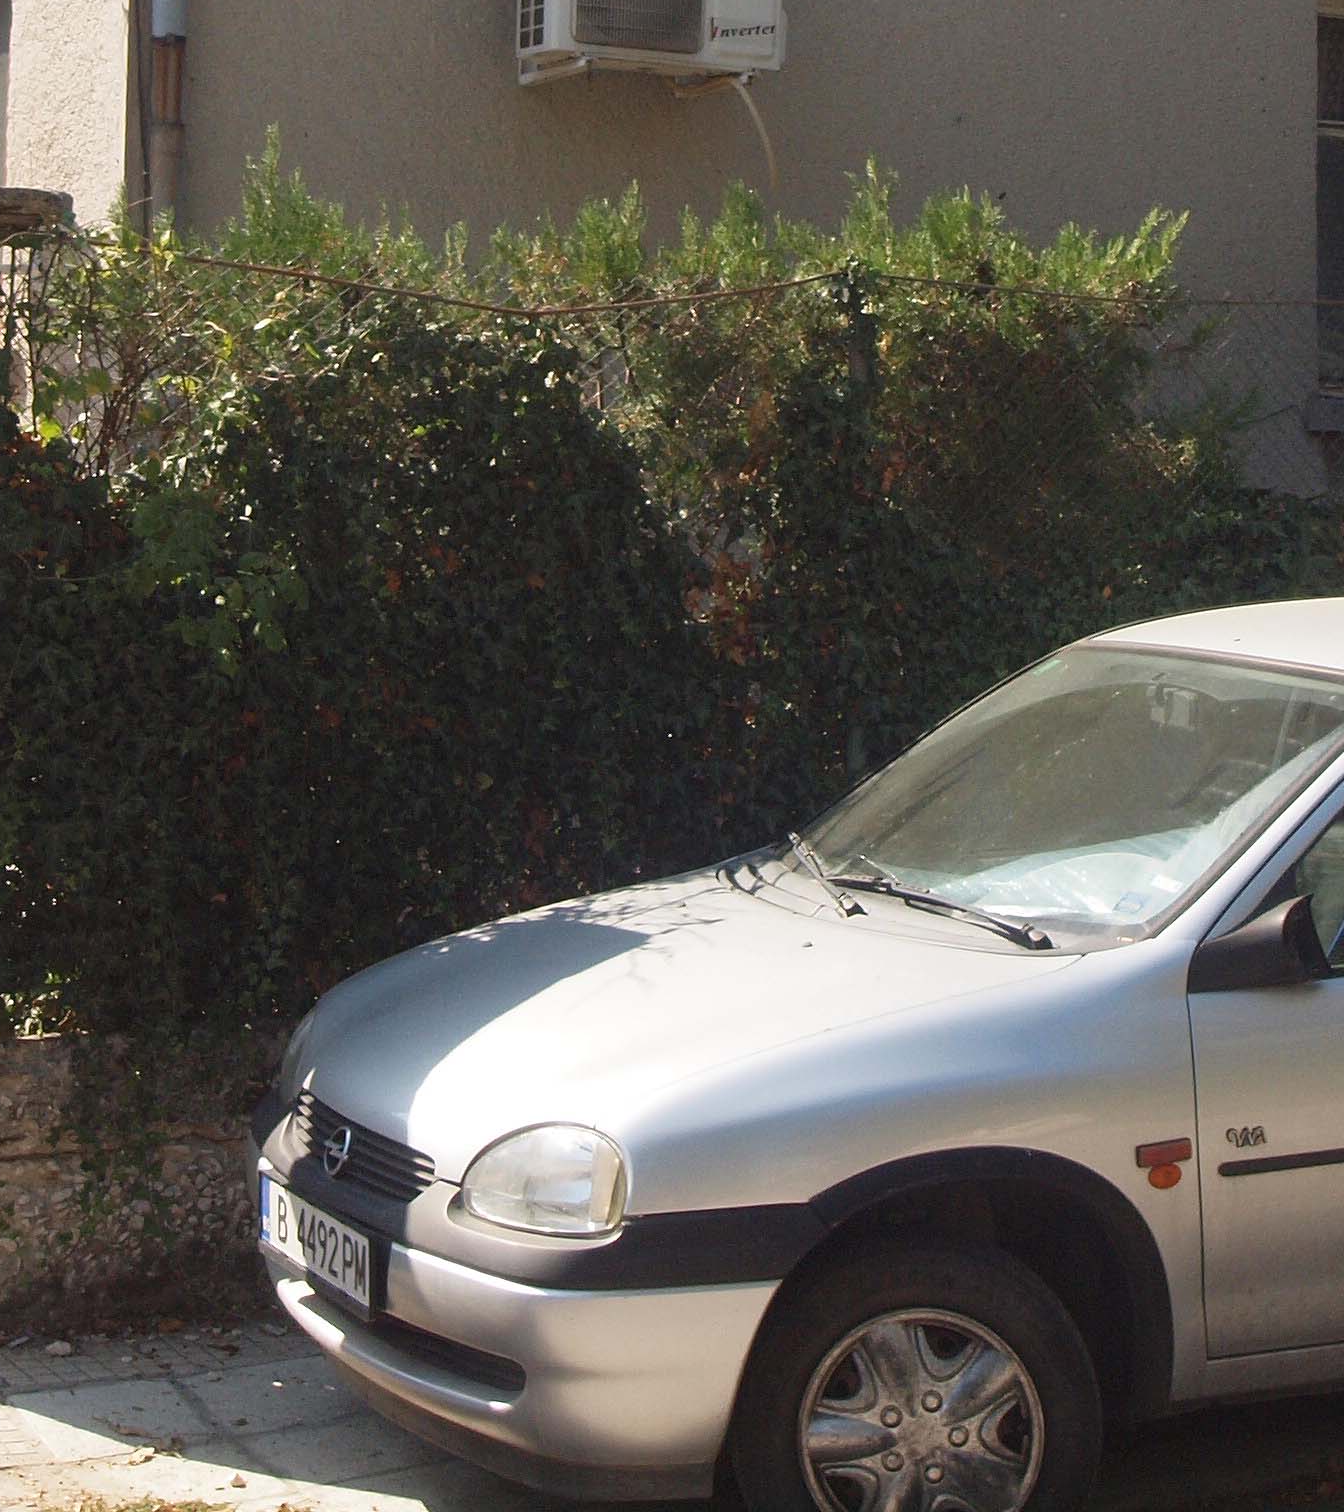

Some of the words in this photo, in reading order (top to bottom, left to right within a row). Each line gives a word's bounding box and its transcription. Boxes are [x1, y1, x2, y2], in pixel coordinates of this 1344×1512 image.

[278, 1194, 287, 1244] B
[297, 1208, 338, 1279] 4492
[343, 1233, 367, 1297] PM
